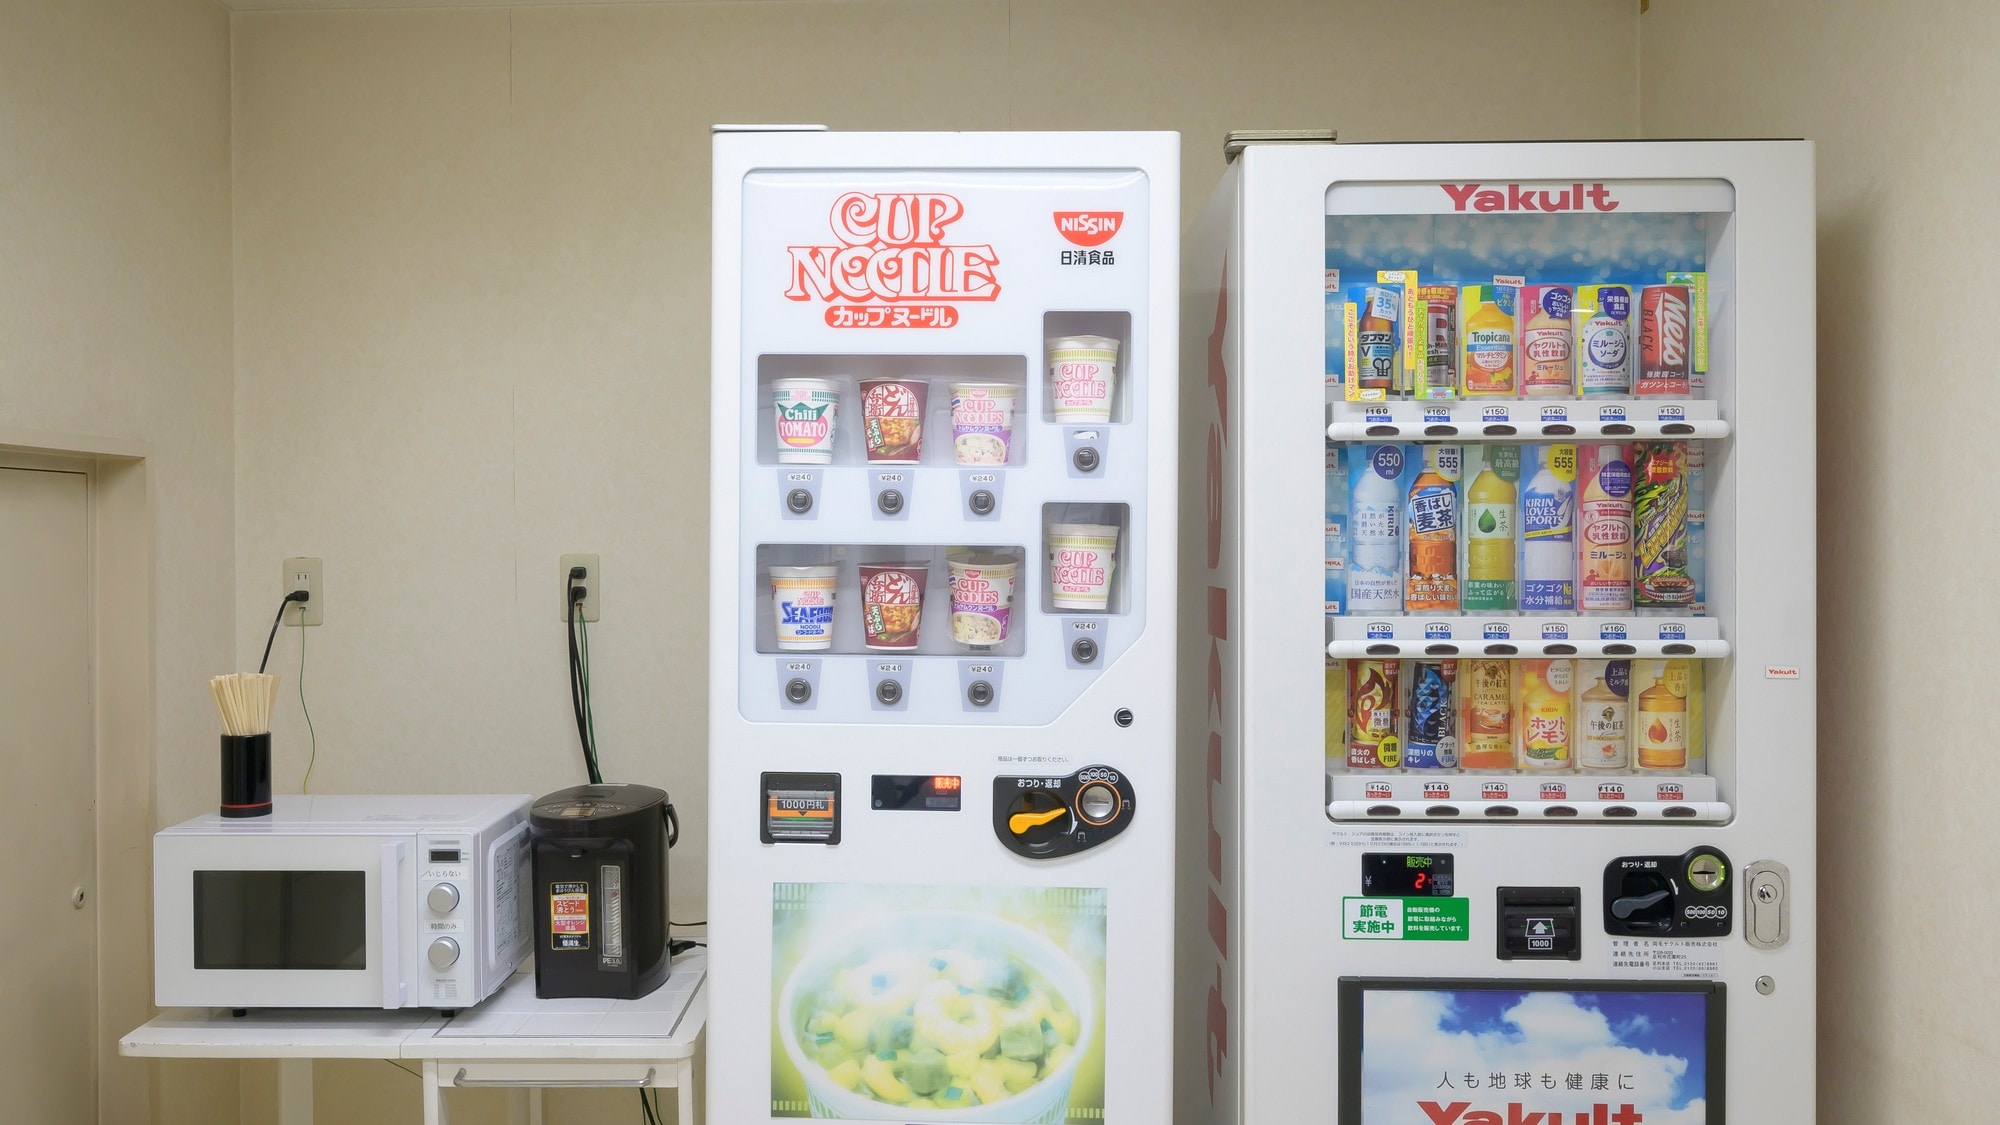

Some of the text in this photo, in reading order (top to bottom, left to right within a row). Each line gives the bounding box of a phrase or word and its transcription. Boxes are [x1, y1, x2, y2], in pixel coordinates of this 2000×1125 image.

[1440, 183, 1620, 212] Yakult
[830, 191, 964, 246] CUP
[1060, 214, 1115, 235] NISSIN
[1060, 249, 1115, 266] 日清食品
[784, 245, 1001, 302] NOODLE
[1495, 278, 1523, 286] Yakult
[1550, 292, 1572, 304] ゴクゴク
[833, 306, 953, 327] カップヌードル
[1642, 308, 1654, 353] BLACK
[1663, 291, 1688, 367] Mets
[1360, 333, 1392, 343] タフマン
[1471, 331, 1511, 343] Tropicana
[1533, 341, 1566, 349] ヤクルトの
[1592, 339, 1625, 348] ミルージュ
[1361, 346, 1371, 358] V
[1533, 350, 1566, 358] 乳性飲料
[1600, 349, 1619, 358] ソーダ
[1060, 363, 1099, 381] CUP
[1053, 380, 1106, 399] NOODLE
[963, 399, 995, 412] CUP
[785, 408, 817, 421] Chili
[954, 410, 1005, 425] NOODLES
[1426, 408, 1447, 416] ¥160
[780, 421, 827, 437] TOMATO
[1378, 453, 1400, 467] 550
[1438, 456, 1458, 468] 555
[1554, 457, 1573, 468] 555
[1414, 497, 1451, 513] 香ばし
[1525, 498, 1554, 508] KIRIN
[1362, 512, 1385, 520] 自然が
[1525, 506, 1556, 516] LOVES
[1387, 505, 1395, 537] KIRIN
[1416, 508, 1453, 531] 麦茶
[1525, 515, 1564, 525] SPORTS
[1592, 523, 1626, 532] ヤクルトの
[1592, 532, 1626, 540] 乳性飲料
[1058, 549, 1098, 568] CUP
[1590, 550, 1627, 560] ミルージュ
[1051, 567, 1105, 586] NOODLE
[958, 578, 989, 592] CUP
[1526, 584, 1563, 592] ゴクゴク
[1350, 588, 1400, 600] 国産天然水
[1525, 596, 1563, 604] 水分補給
[1206, 247, 1228, 1108] Yakult
[1475, 679, 1508, 688] 午後の紅茶
[1438, 699, 1448, 738] BLACK
[1530, 716, 1566, 730] ホット
[1590, 720, 1624, 730] 午後の紅茶
[1674, 718, 1682, 743] 生茶
[1526, 730, 1569, 744] レモン
[1350, 756, 1377, 764] 香ばしさ
[1408, 756, 1420, 764] キレ
[1017, 778, 1062, 788] おつり・返却
[781, 800, 825, 810] 1000円札
[1406, 856, 1432, 868] 販売中
[1621, 861, 1658, 869] おつり・返却
[1365, 875, 1372, 886] ¥
[1415, 872, 1426, 888] 2
[1360, 904, 1388, 918] 節電
[1352, 920, 1395, 934] 実施中
[1532, 940, 1550, 948] 1000
[1436, 1072, 1635, 1090] 人も地球も健康に
